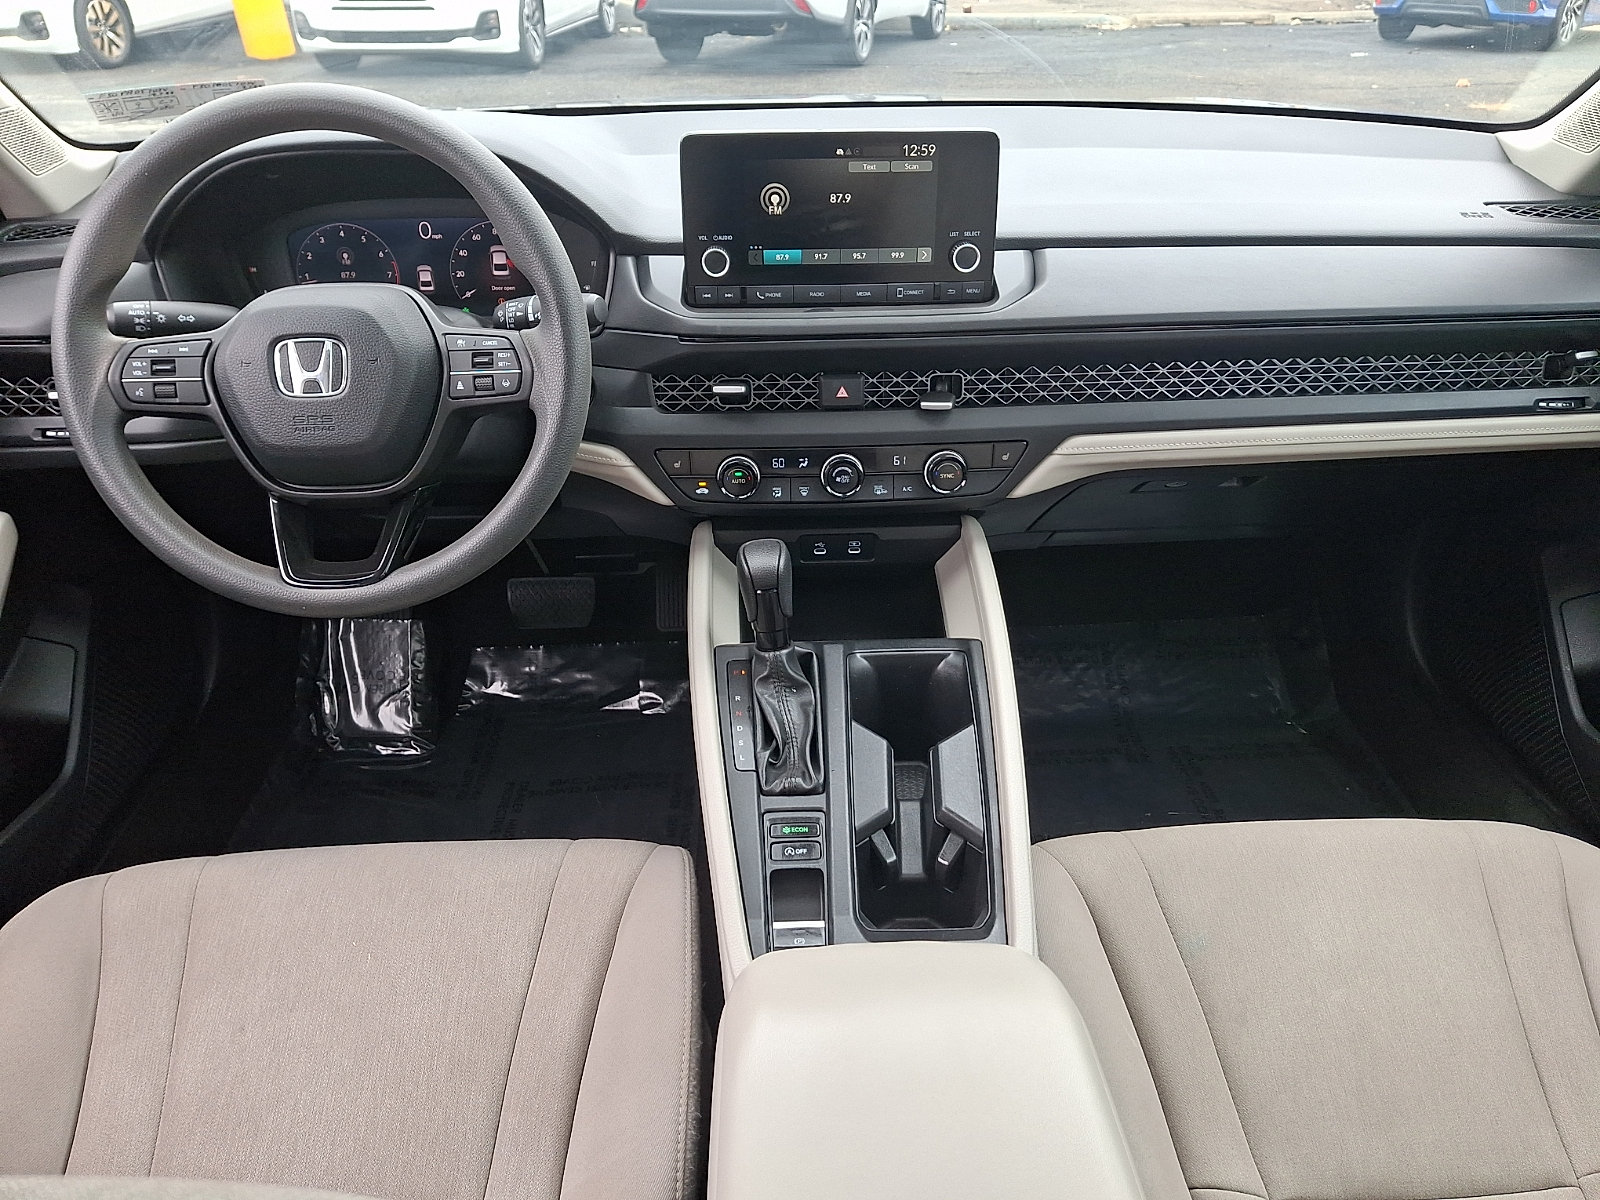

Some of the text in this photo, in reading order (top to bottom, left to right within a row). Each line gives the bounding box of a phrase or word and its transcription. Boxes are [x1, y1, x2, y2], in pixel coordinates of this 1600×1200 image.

[902, 144, 936, 157] 12:59
[829, 193, 852, 203] 87.9
[768, 205, 782, 215] FM
[418, 221, 432, 239] 0
[319, 236, 325, 244] 3
[361, 235, 366, 243] 5
[471, 233, 481, 241] 60
[306, 252, 313, 260] 2
[378, 250, 384, 258] 6
[458, 249, 468, 257] 40
[775, 253, 790, 261] 87.9
[890, 251, 905, 259] 99.9
[304, 272, 310, 280] 1
[340, 271, 356, 279] 87.9
[386, 271, 392, 279] 7
[455, 270, 465, 278] 20
[772, 457, 785, 468] 60
[893, 455, 907, 466] 61
